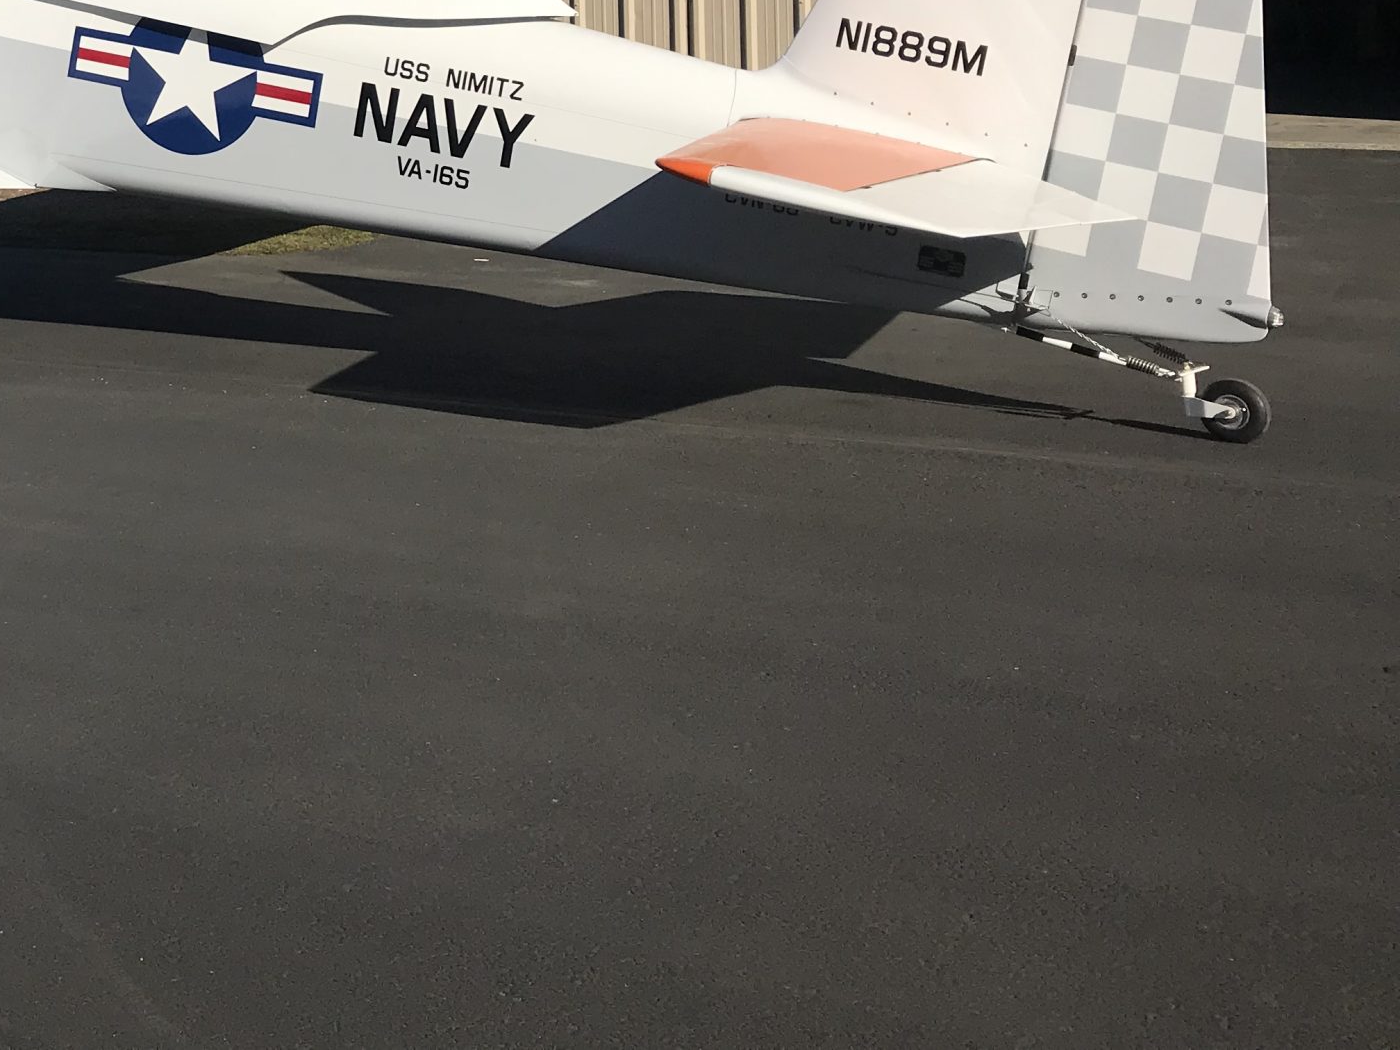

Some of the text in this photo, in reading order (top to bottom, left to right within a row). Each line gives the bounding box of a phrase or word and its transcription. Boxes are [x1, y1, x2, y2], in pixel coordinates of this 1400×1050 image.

[835, 17, 989, 77] N1889M
[384, 56, 525, 101] USS NIMITZ
[353, 81, 536, 169] NAVY
[397, 155, 471, 190] VA-165
